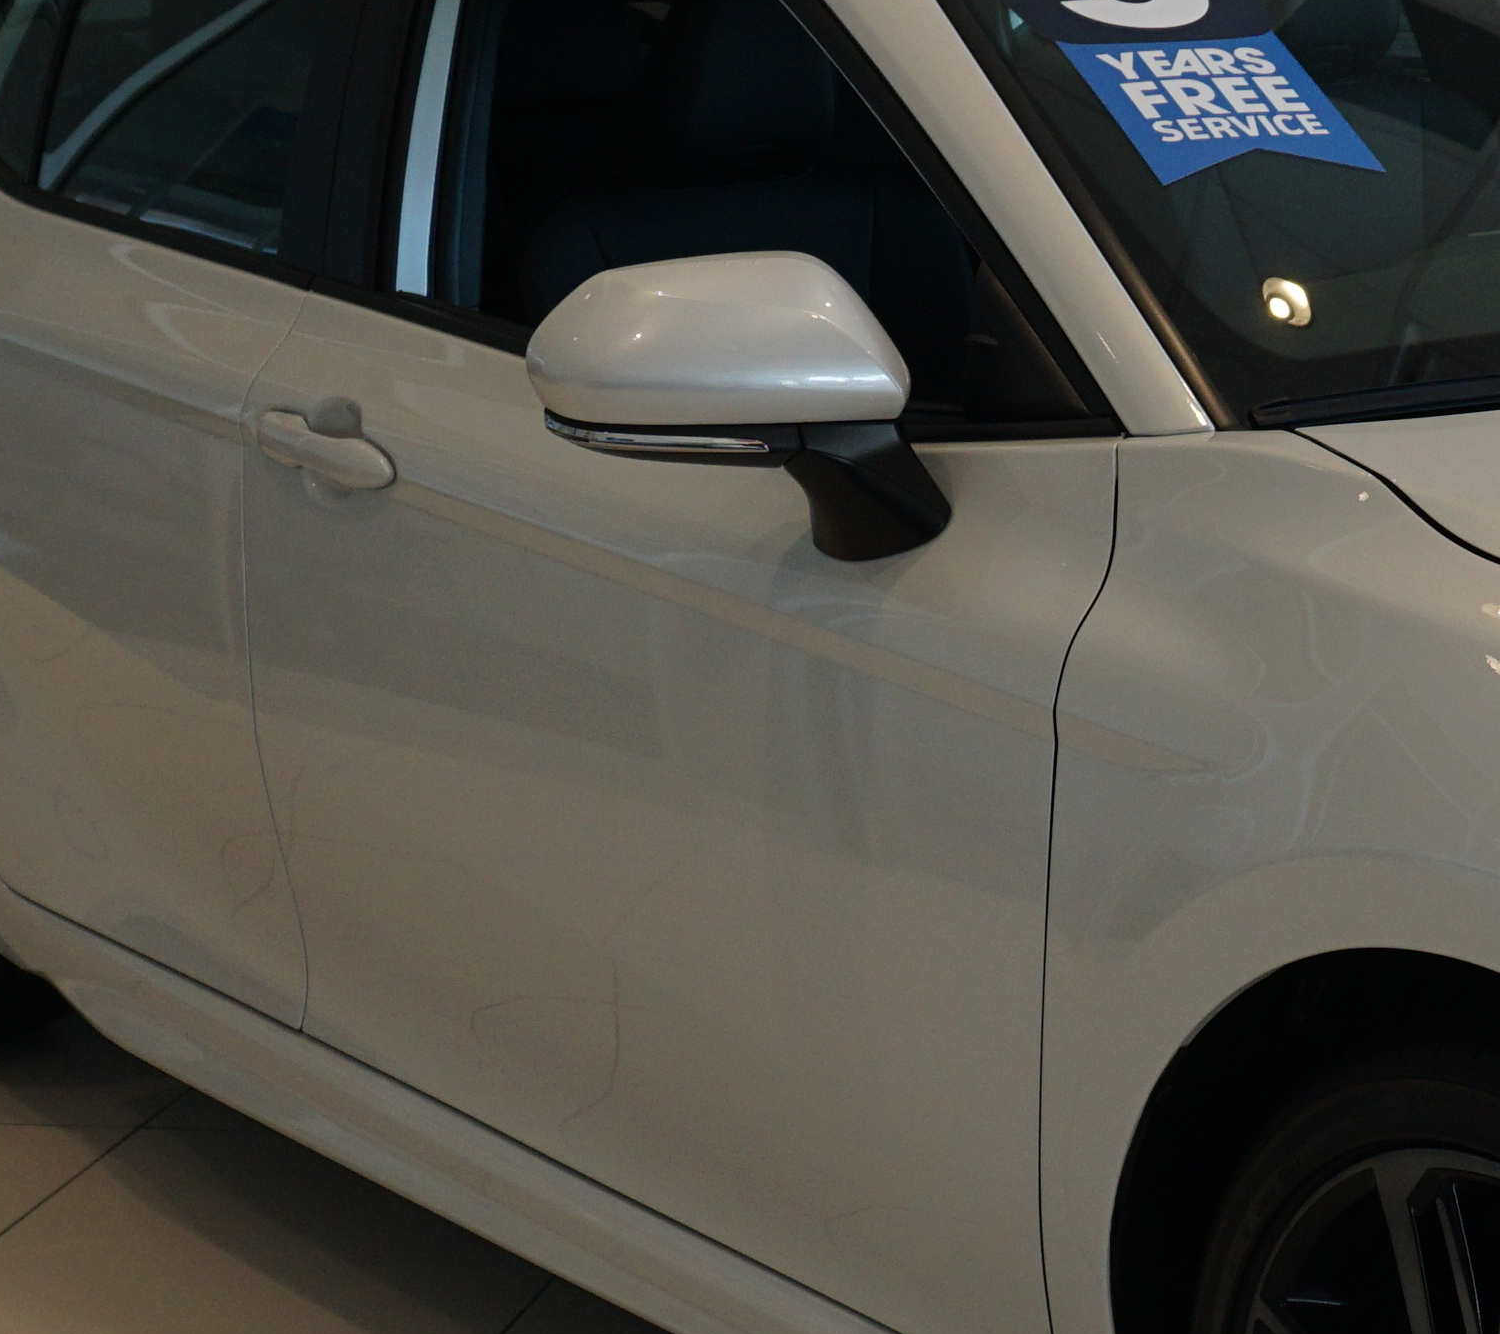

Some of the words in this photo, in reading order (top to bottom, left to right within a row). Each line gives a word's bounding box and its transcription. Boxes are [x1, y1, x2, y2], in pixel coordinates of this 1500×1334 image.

[1095, 47, 1276, 80] YEARS
[1119, 76, 1311, 120] FREE
[1152, 113, 1330, 142] SERVICE
